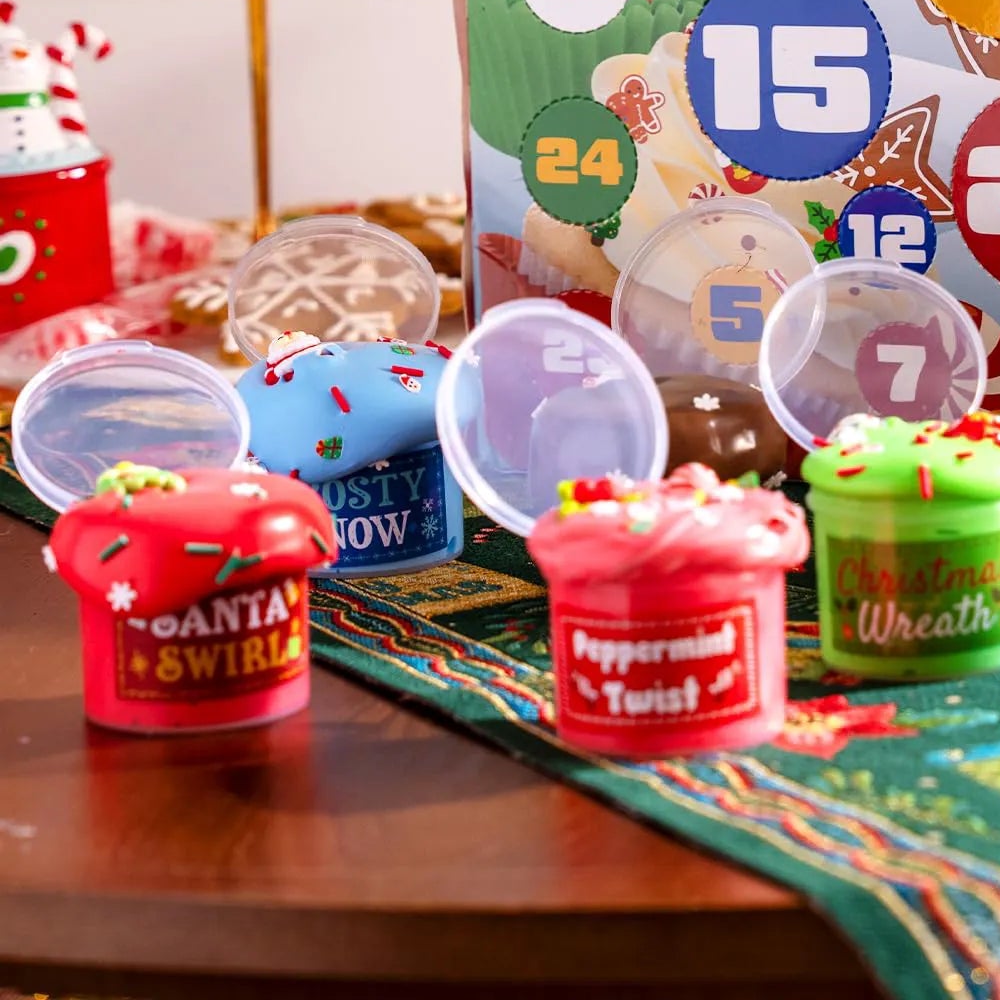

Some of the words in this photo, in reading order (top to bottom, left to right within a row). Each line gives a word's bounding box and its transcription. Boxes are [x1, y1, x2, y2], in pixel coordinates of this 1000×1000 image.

[702, 24, 871, 133] 15
[535, 137, 623, 185] 24
[847, 213, 926, 264] 12
[710, 285, 764, 342] 5
[876, 345, 926, 401] 7
[312, 467, 426, 511] OSTY
[333, 509, 411, 550] NOW
[858, 592, 998, 645] Wreath
[156, 630, 292, 682] SWIRL
[573, 620, 737, 675] Peppermint
[601, 675, 699, 715] Twist
